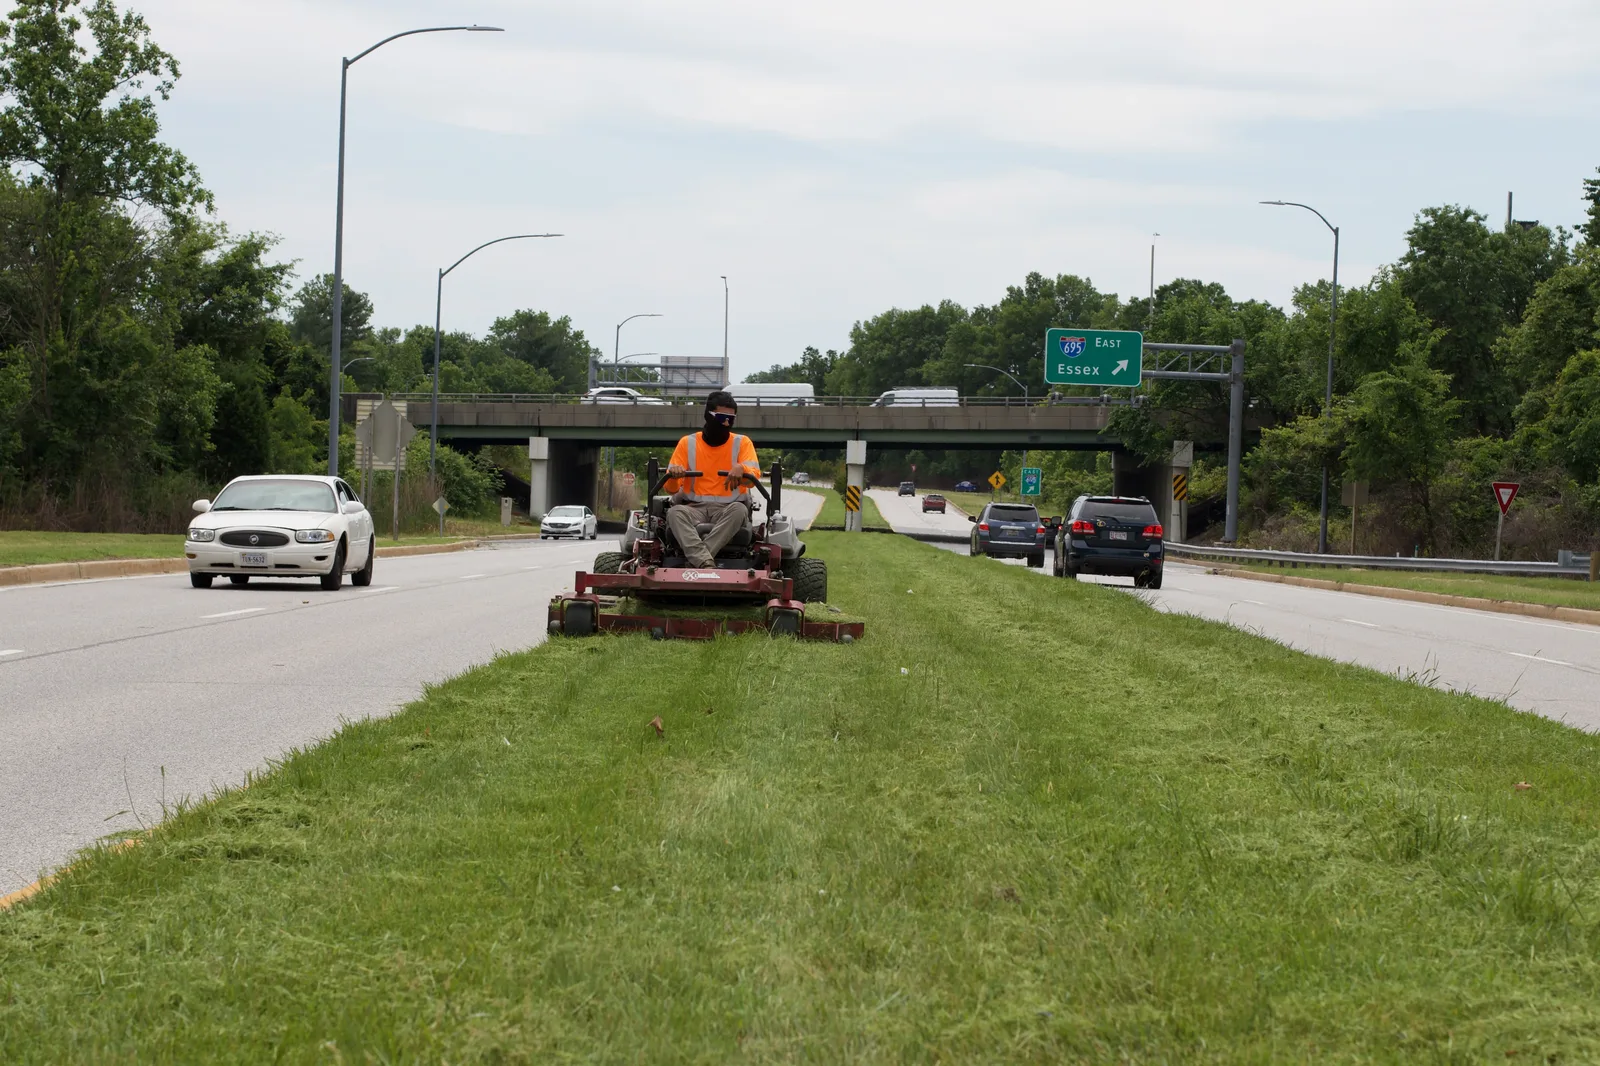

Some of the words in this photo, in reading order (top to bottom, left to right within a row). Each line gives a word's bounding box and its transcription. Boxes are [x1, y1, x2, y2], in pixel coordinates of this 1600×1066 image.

[1064, 342, 1082, 354] 695
[1095, 337, 1122, 348] EAST
[1057, 363, 1100, 376] Essex
